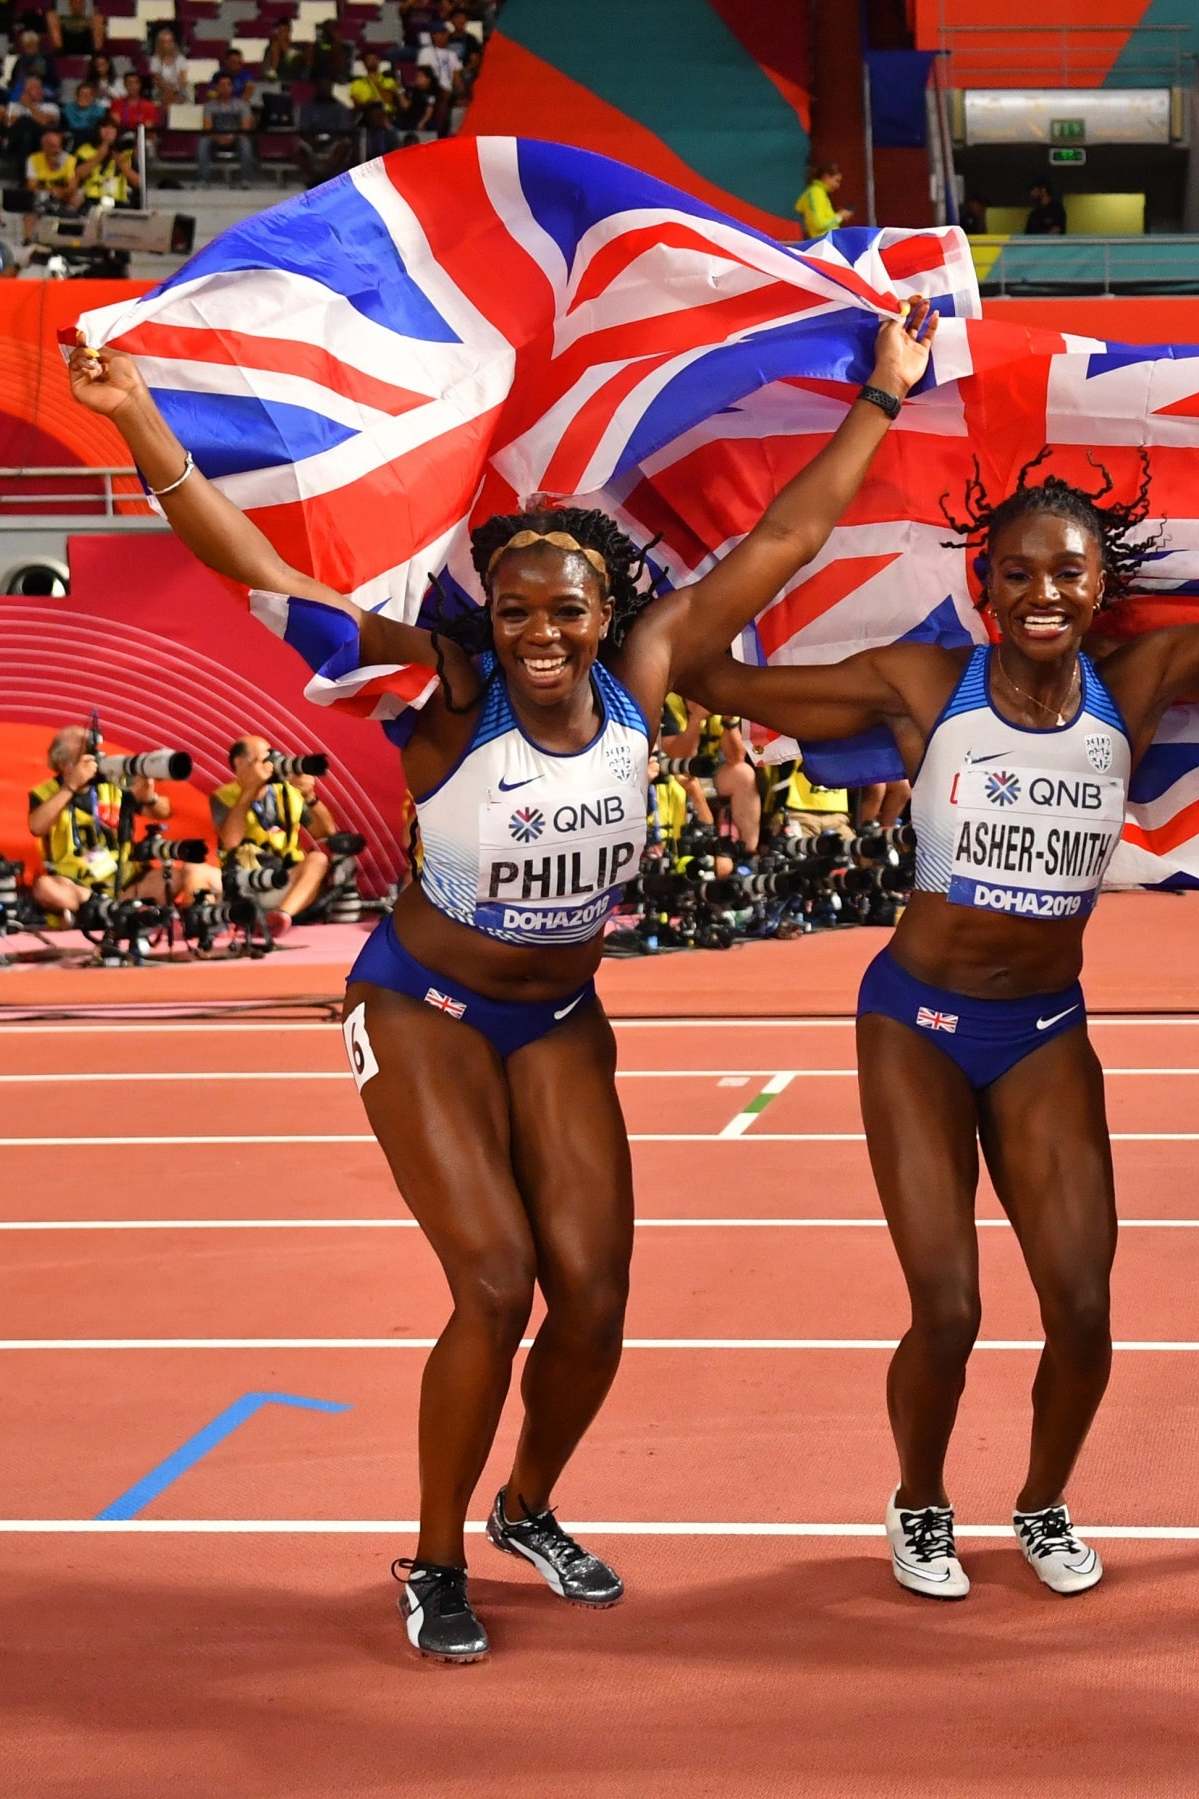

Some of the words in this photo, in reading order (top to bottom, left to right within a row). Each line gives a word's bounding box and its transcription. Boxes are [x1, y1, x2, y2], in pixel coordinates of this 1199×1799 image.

[1029, 778, 1102, 810] QNB
[553, 796, 625, 833] QNB
[955, 821, 1112, 878] ASHER-SMITH
[488, 842, 634, 899] PHILIP
[503, 895, 610, 931] DOHA2019
[974, 885, 1082, 917] DOHA2019
[351, 1022, 365, 1075] 6
